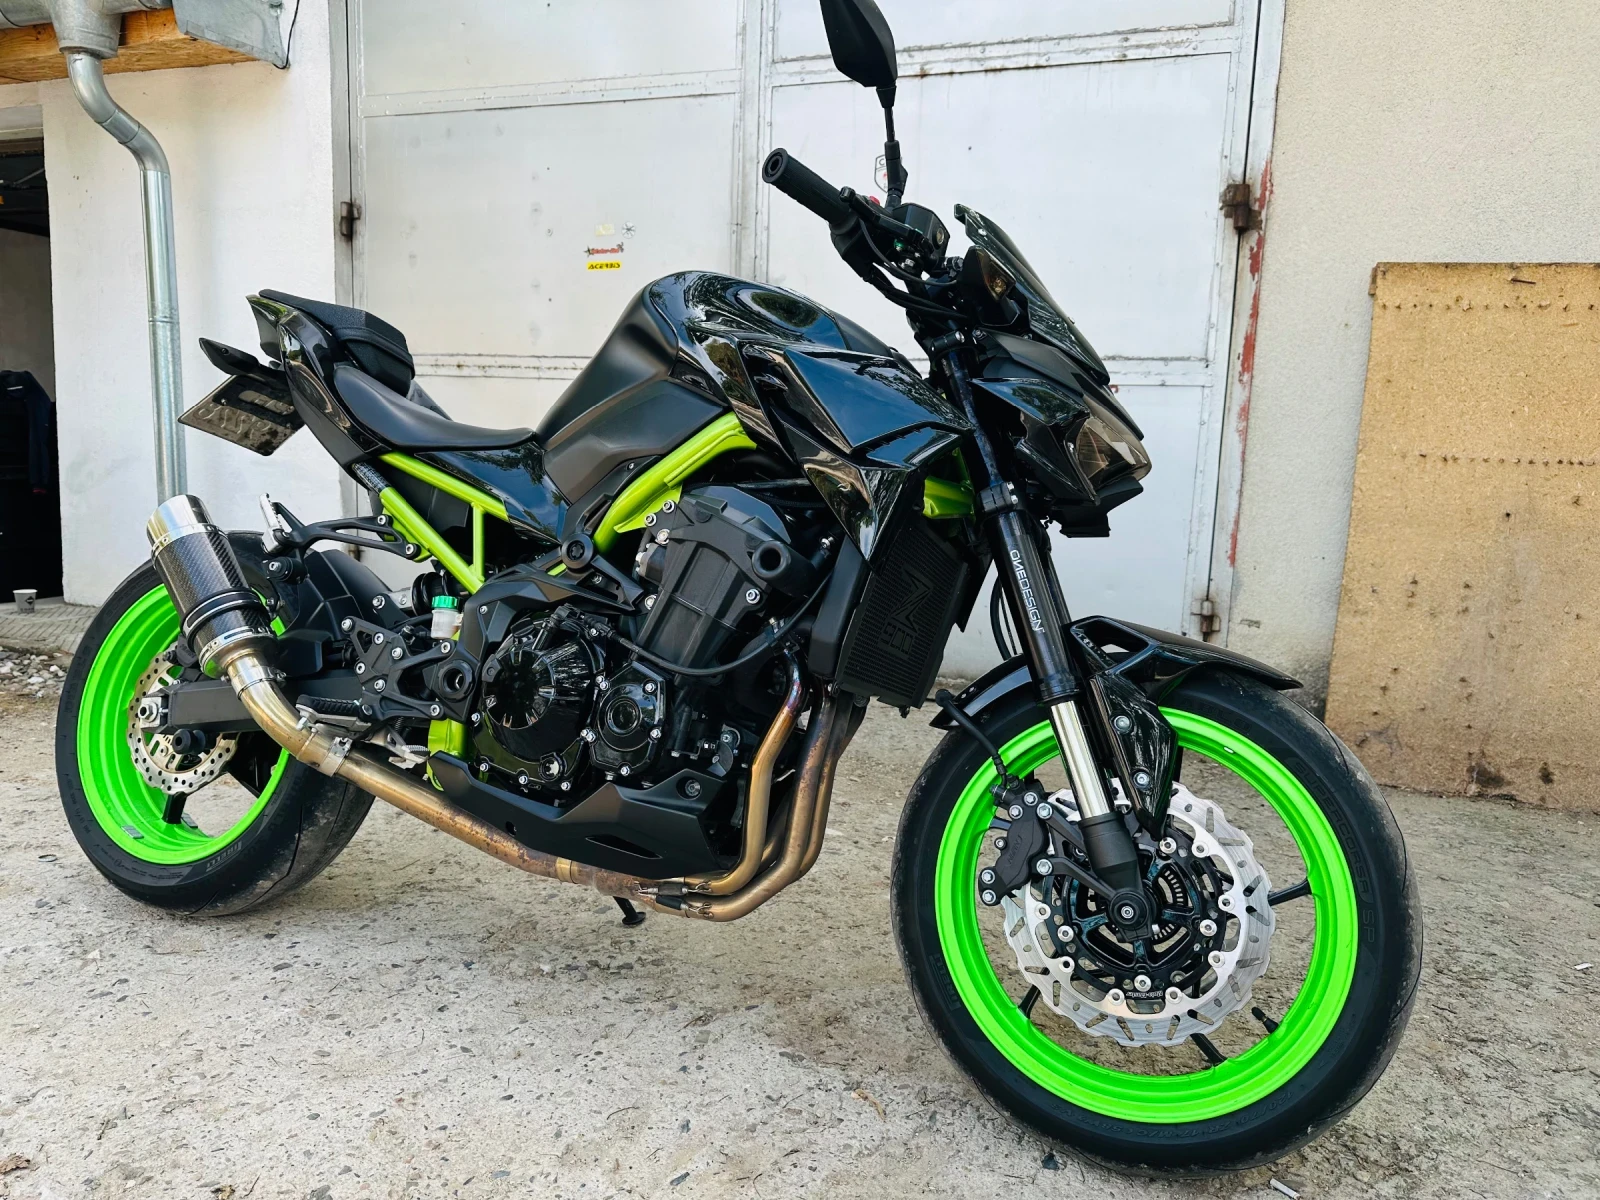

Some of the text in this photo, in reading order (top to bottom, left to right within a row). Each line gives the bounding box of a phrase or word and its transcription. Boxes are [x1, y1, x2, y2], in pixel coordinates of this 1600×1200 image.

[1009, 549, 1044, 632] ONEDESIGN
[203, 839, 244, 872] PIRELLI
[1291, 759, 1375, 943] SUPERCORSA SP
[931, 951, 963, 1012] PIRELLI
